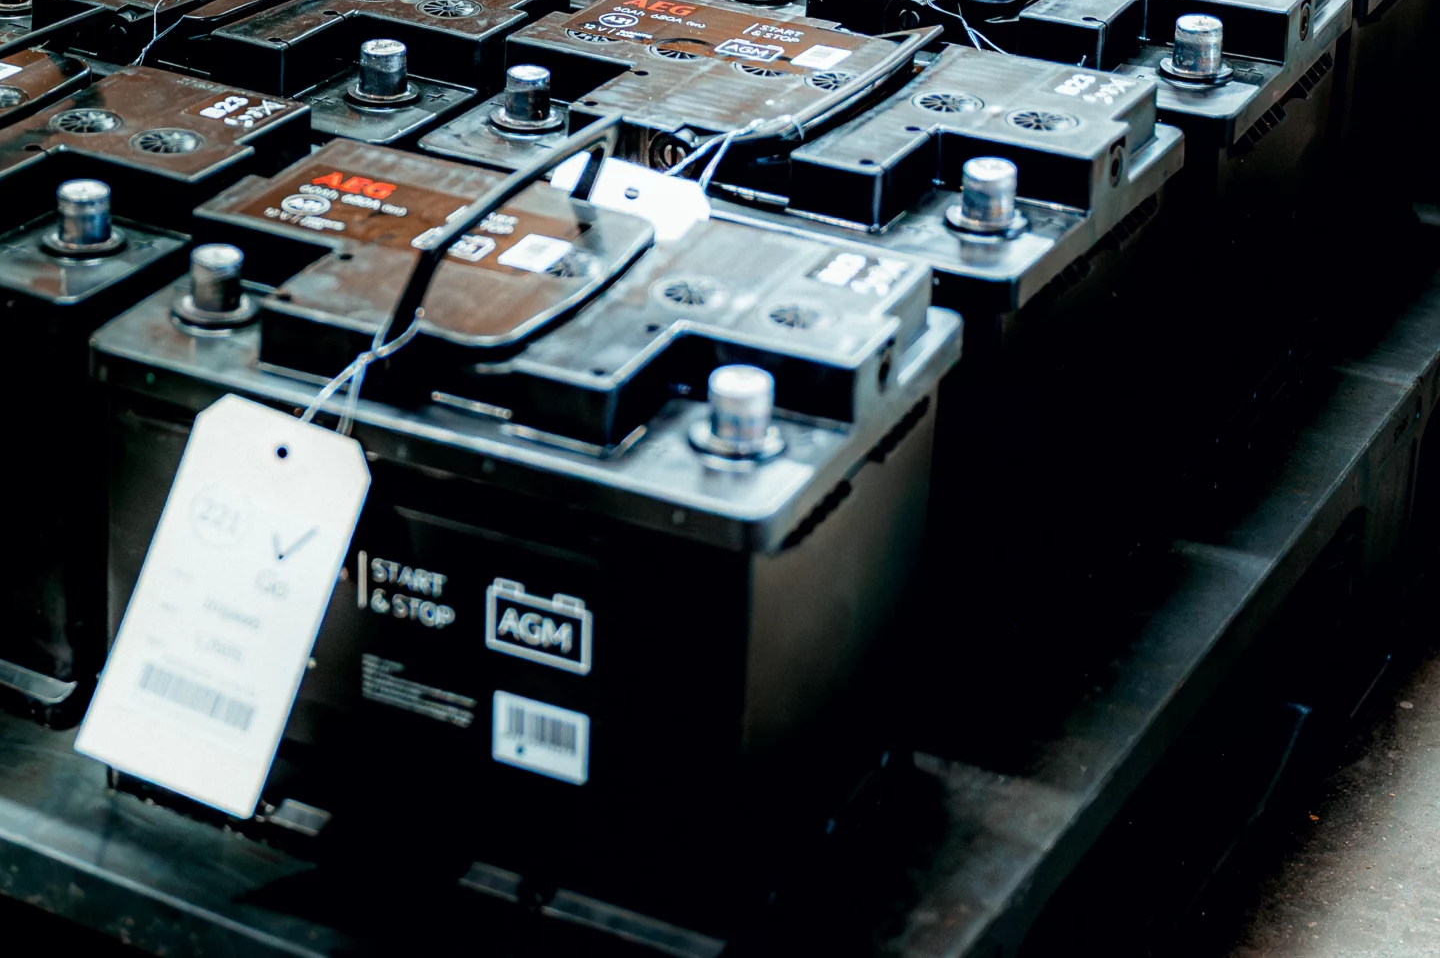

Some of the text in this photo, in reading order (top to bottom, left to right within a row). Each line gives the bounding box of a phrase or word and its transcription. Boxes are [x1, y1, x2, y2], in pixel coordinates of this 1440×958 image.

[760, 23, 805, 37] START
[763, 31, 801, 43] STOP
[724, 43, 770, 57] AGM
[371, 558, 448, 599] START
[371, 588, 457, 629] & STOP
[497, 607, 572, 654] AGM
